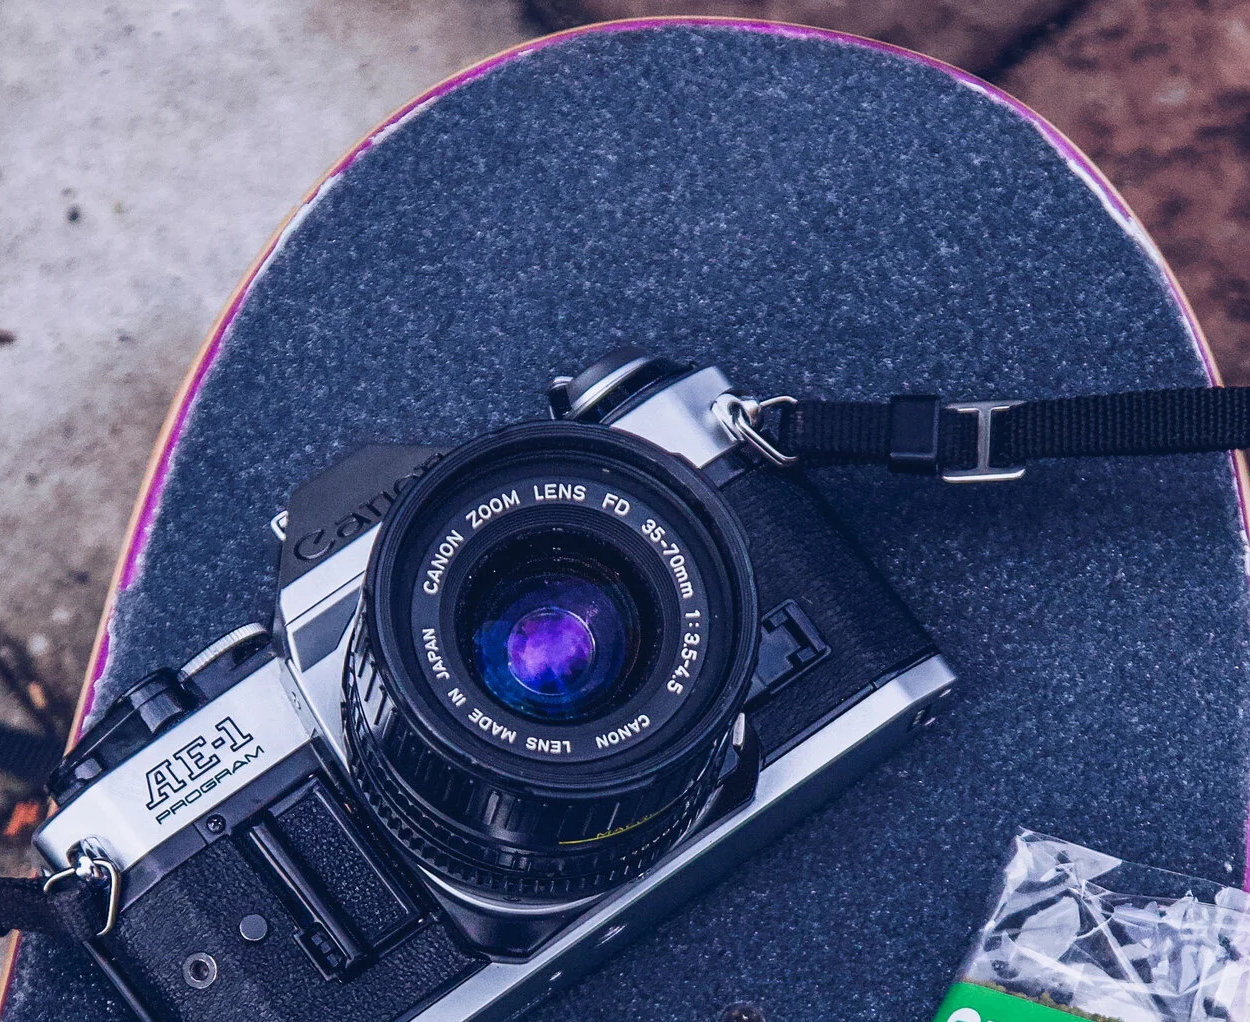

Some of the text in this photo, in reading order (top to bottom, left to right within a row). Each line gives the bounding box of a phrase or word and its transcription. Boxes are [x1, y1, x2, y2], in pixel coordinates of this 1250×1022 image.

[423, 529, 464, 595] CANON
[465, 489, 521, 529] ZOOM
[533, 483, 587, 501] LENS
[602, 493, 631, 516] FD
[641, 518, 694, 600] 35-70mm
[422, 628, 651, 754] CANON LENS MADE IN JAPAN
[145, 716, 254, 811] AE-1
[155, 745, 265, 825] PROGRAM
